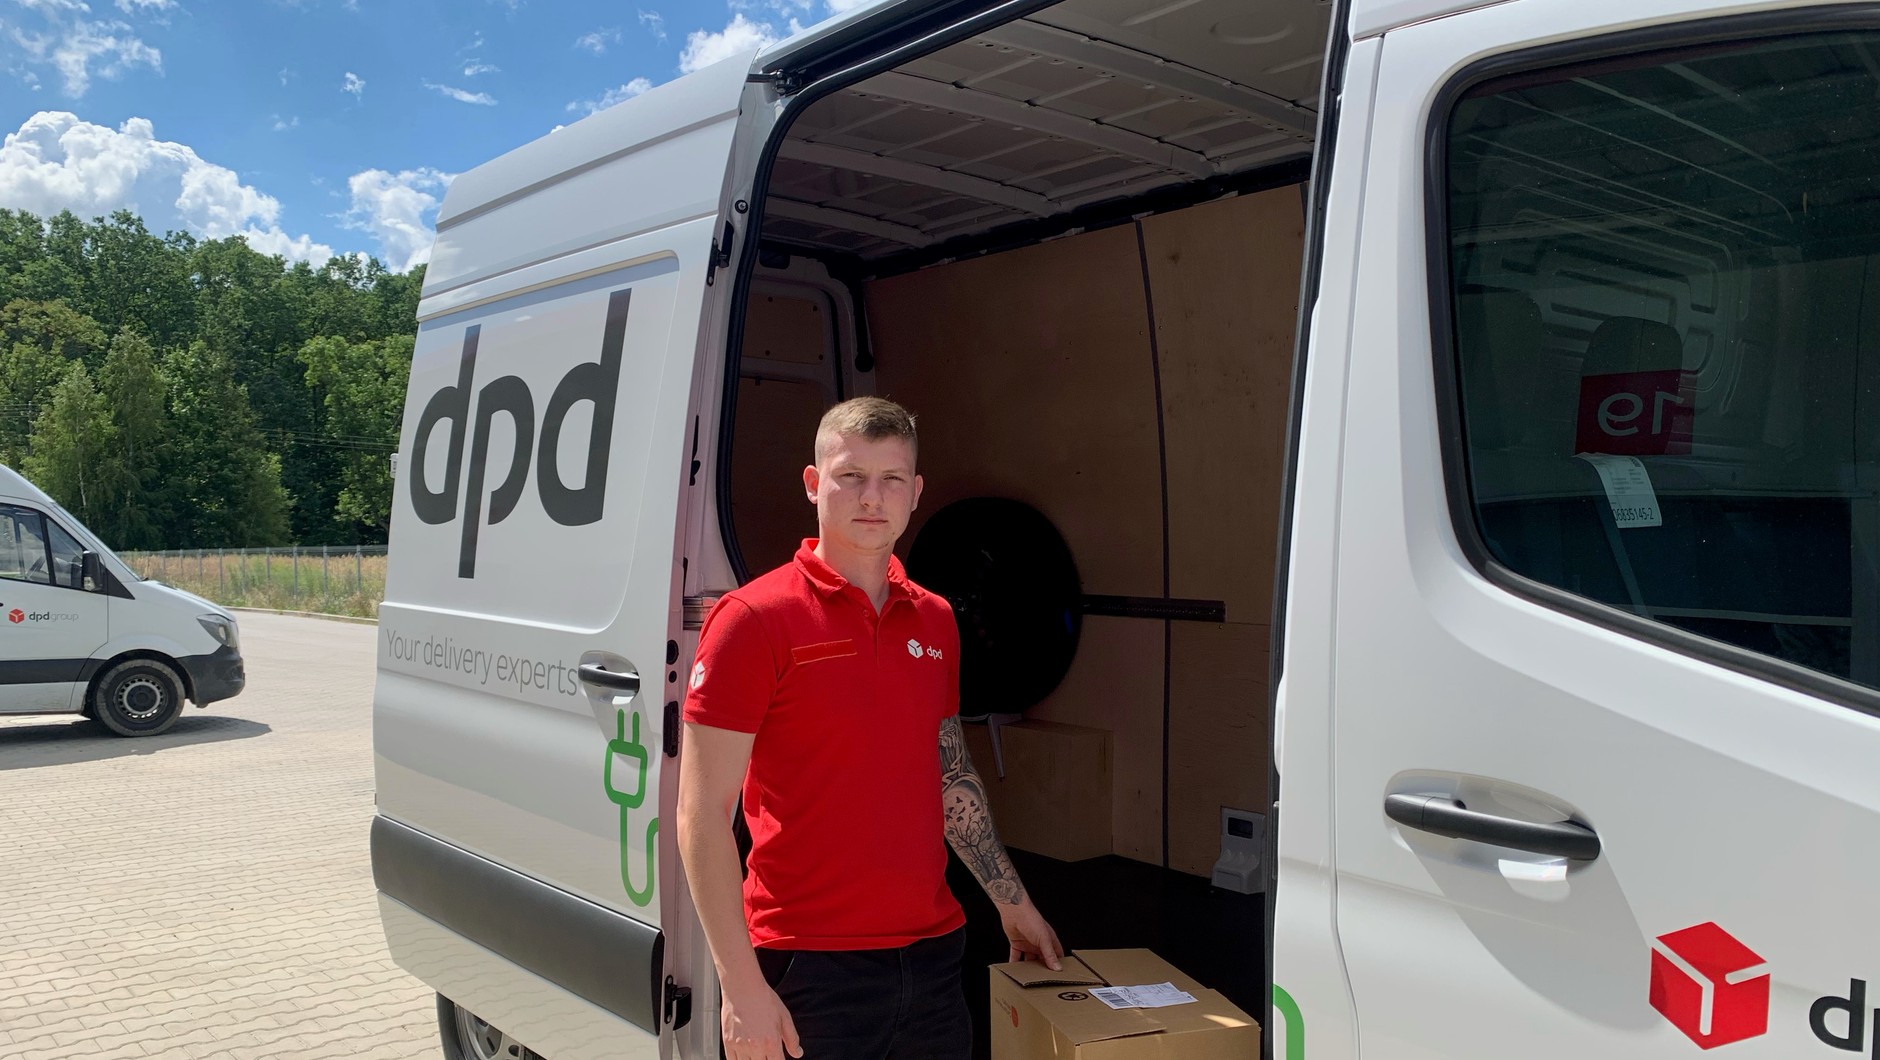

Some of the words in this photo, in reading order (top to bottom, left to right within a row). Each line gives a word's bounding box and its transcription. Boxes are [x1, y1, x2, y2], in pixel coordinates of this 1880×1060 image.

[410, 288, 632, 578] dpd
[387, 630, 421, 662] Your
[423, 635, 493, 684] delivery
[496, 654, 578, 696] experts
[926, 645, 943, 660] dpd
[1809, 977, 1880, 1060] d
